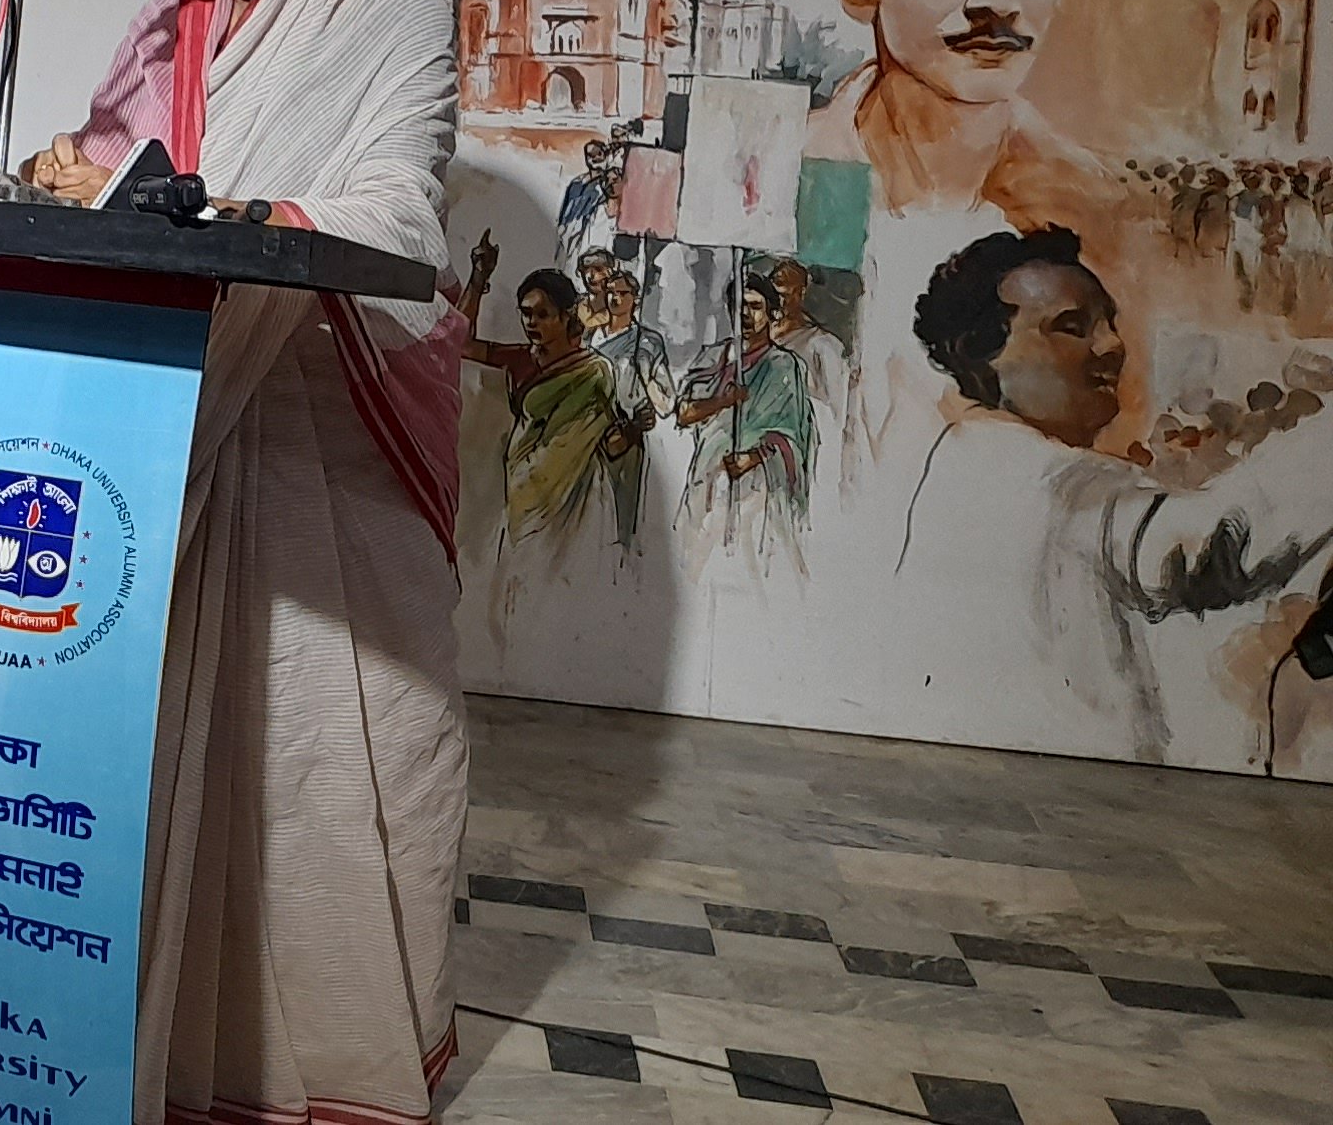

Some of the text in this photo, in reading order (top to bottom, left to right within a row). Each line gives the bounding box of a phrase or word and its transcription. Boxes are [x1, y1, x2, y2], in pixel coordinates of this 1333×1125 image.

[42, 482, 77, 515] আলো
[51, 441, 138, 665] DHAKA UNIVERSITY ALUMNI ASSOCIATION
